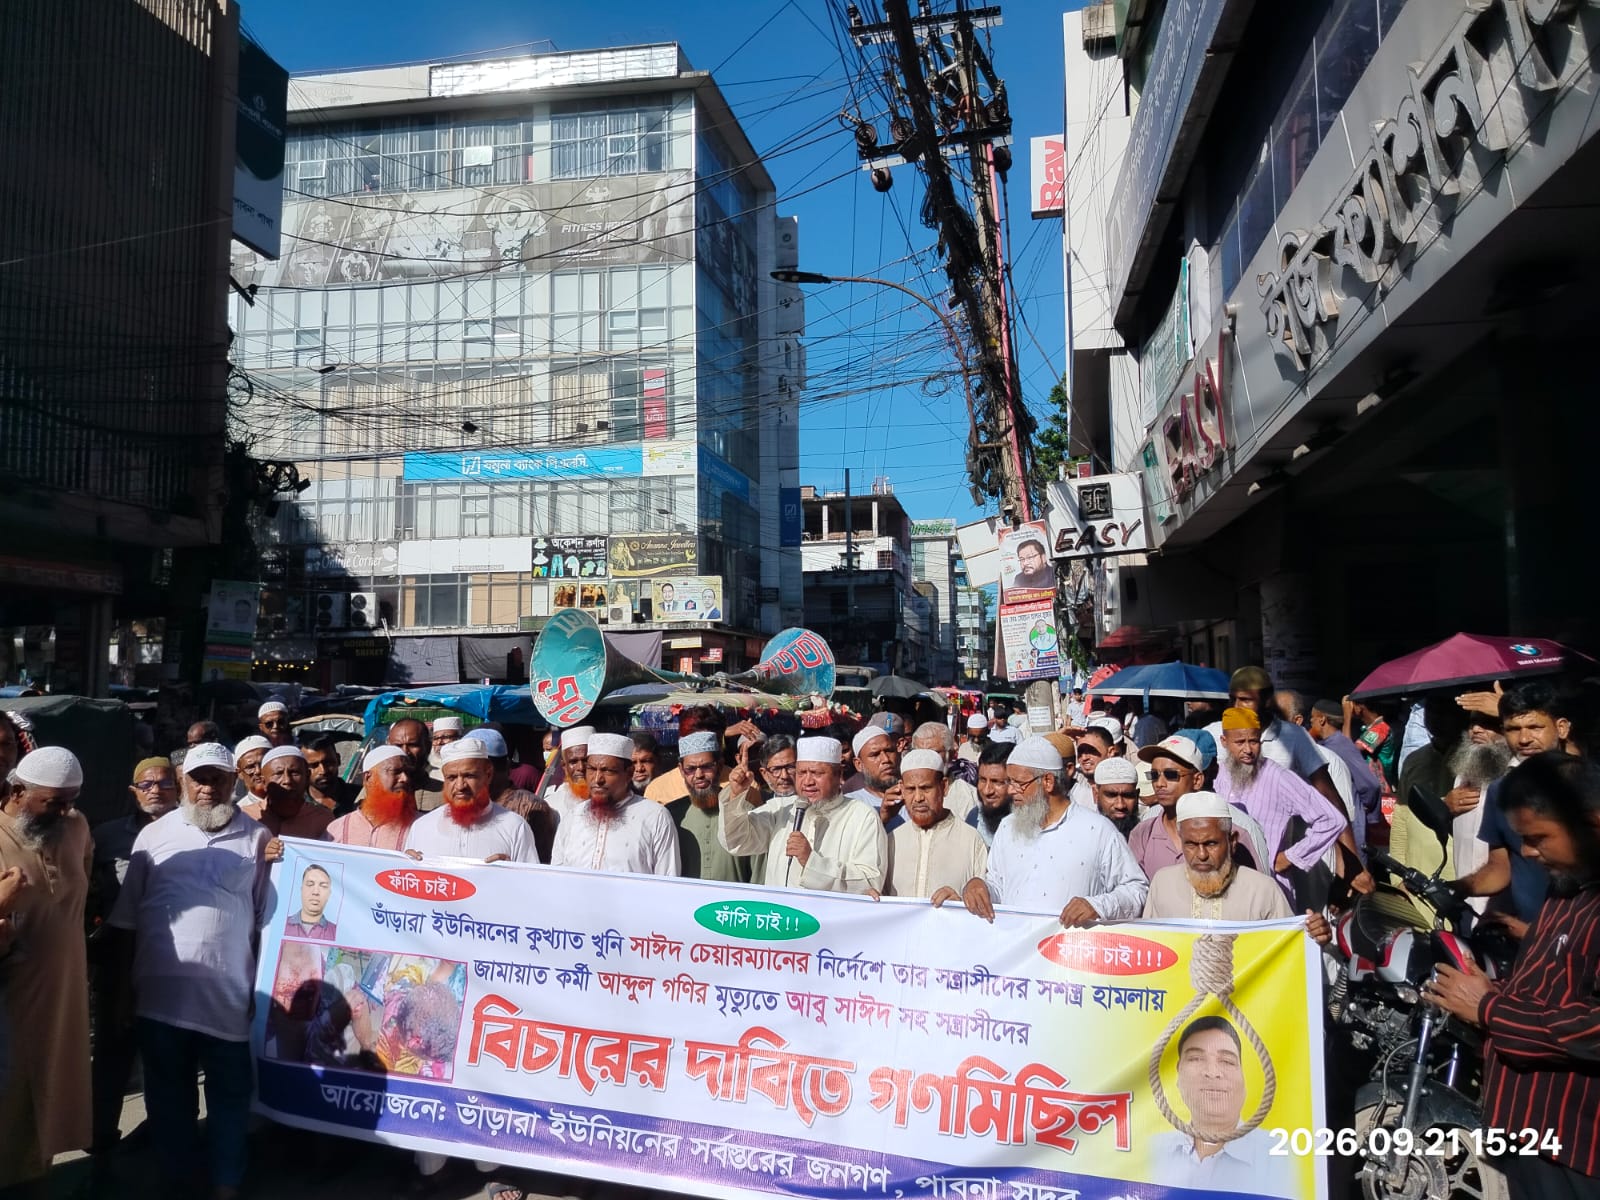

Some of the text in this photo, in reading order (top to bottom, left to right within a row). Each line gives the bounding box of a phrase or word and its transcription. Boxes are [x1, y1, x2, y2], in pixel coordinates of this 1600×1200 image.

[483, 458, 511, 472] যমুনা
[514, 458, 543, 471] ব্যাংক
[1055, 519, 1142, 553] EASY
[321, 554, 384, 569] Online Corner
[388, 869, 420, 894] ফাঁসি
[715, 905, 750, 928] ফাঁসি
[370, 902, 425, 934] ভাঁড়ারা
[431, 910, 520, 942] ইউনিয়নের
[526, 925, 585, 954] কুখ্যাত
[591, 930, 626, 958] খুনি
[630, 934, 684, 963] সাঈদ
[689, 942, 810, 974] চেয়ারম্যানের
[817, 947, 887, 983] নির্দেশে
[892, 962, 928, 986] তার
[1092, 986, 1168, 1013] হামলায়
[474, 958, 549, 988] জামায়াত
[556, 963, 593, 992] কর্মী
[597, 970, 655, 998] আব্দুল
[661, 974, 710, 1003] গণির
[715, 983, 780, 1018] মৃত্যুতে
[785, 990, 828, 1027] আবু
[834, 992, 893, 1028] সাঈদ
[899, 1005, 930, 1034] সহ
[468, 994, 1134, 1155] বিচারের দাবিতে গণমিছিল
[455, 1096, 541, 1140] ভাঁড়ারা
[546, 1110, 680, 1160] ইউনিয়নের
[688, 1132, 797, 1178] সর্বস্তরের
[914, 1173, 1000, 1200] পাবনা
